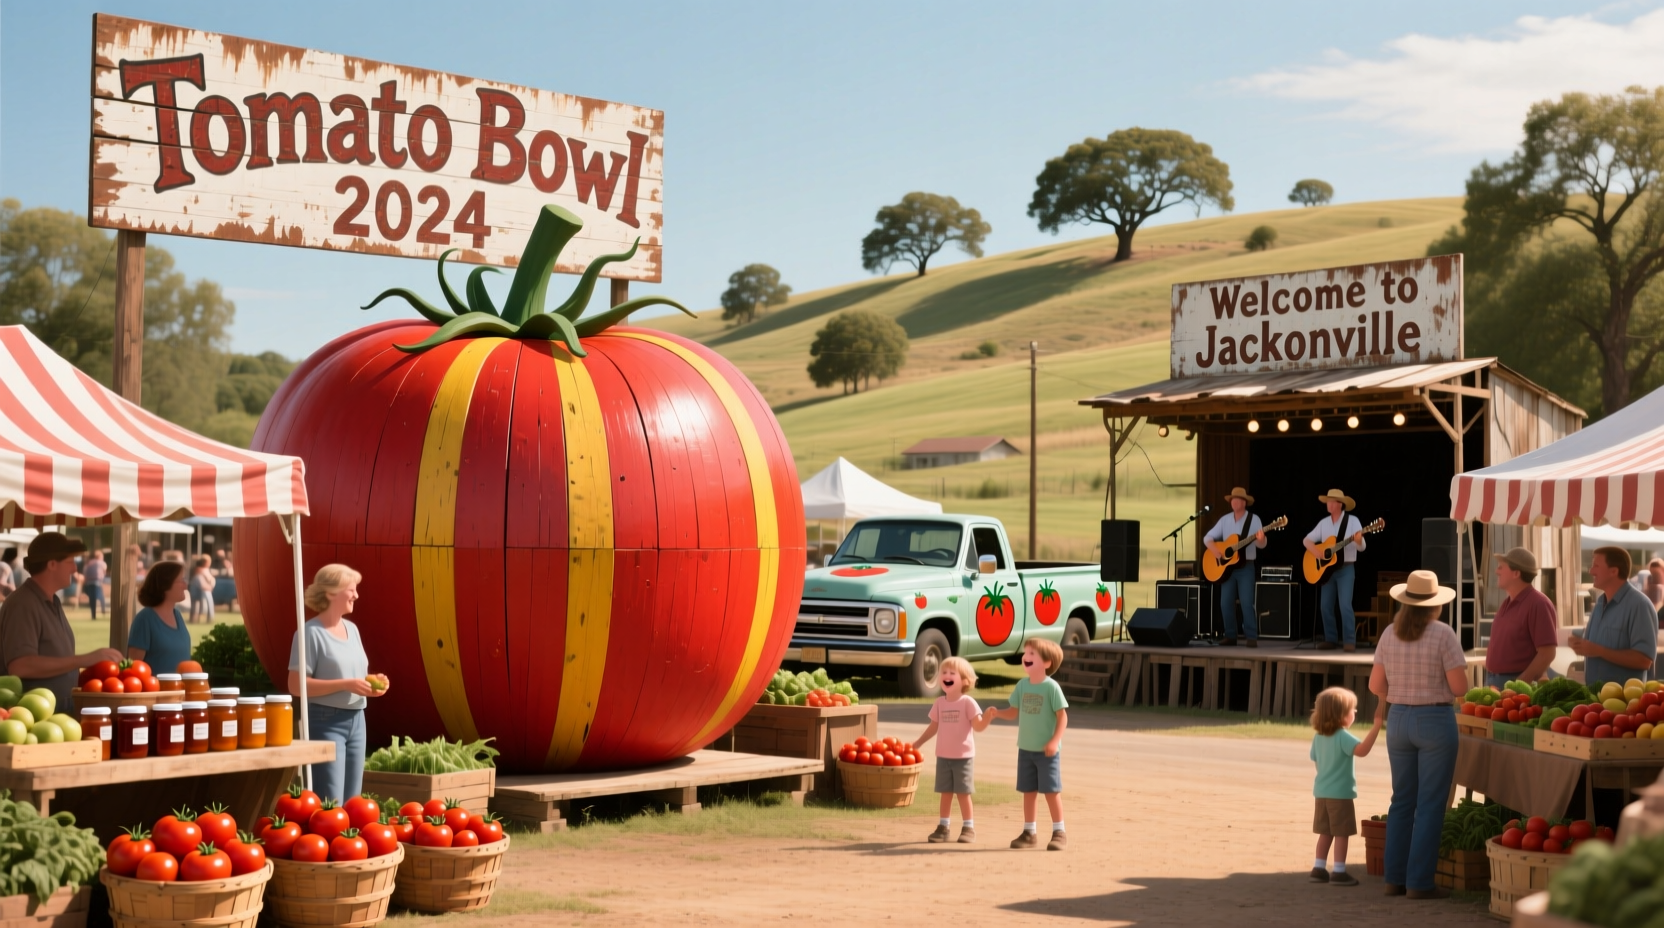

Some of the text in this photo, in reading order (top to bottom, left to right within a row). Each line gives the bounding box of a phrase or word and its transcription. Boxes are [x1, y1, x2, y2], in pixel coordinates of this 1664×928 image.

[119, 53, 649, 228] Tomato Bowl
[333, 176, 492, 248] 2024
[1210, 271, 1419, 320] Welcome to
[1196, 310, 1421, 368] Jackonville
